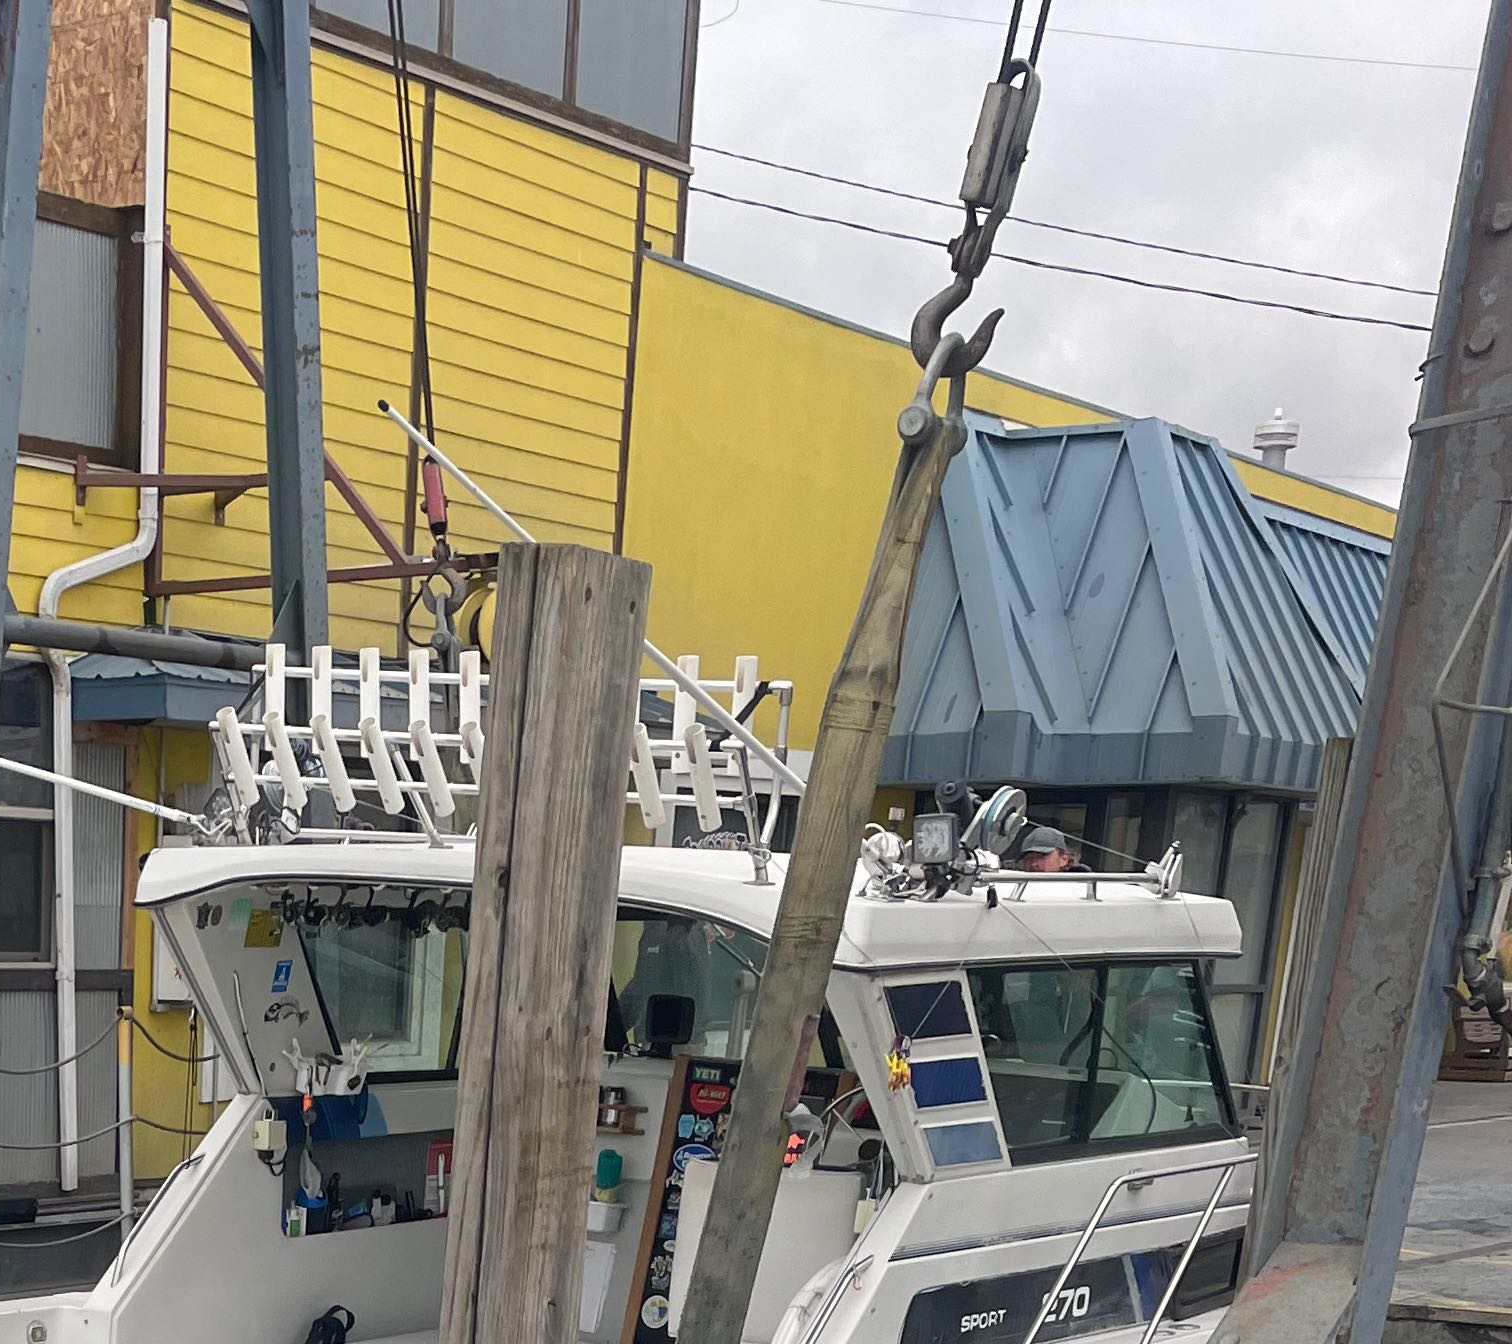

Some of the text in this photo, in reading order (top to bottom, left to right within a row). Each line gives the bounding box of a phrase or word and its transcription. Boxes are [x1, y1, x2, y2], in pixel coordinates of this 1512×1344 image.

[694, 1067, 721, 1081] YETI
[960, 1286, 1091, 1333] SPORT 270
